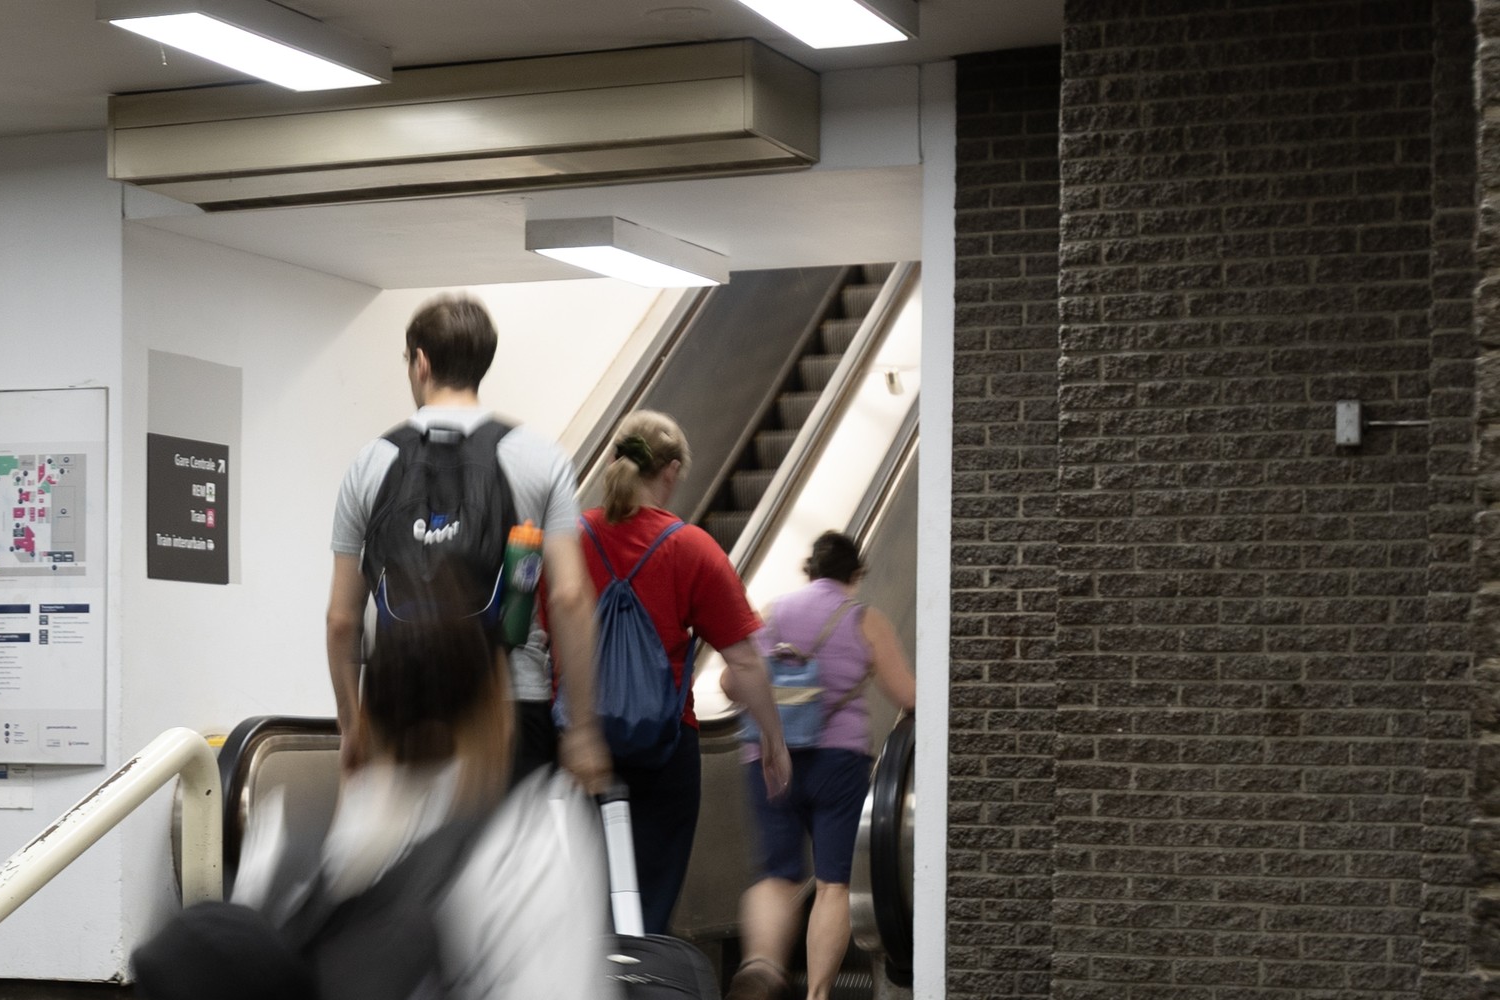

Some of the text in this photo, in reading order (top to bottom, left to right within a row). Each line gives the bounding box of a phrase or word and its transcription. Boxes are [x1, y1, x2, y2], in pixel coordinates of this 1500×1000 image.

[174, 453, 216, 471] Gare Centrale
[190, 509, 206, 523] Train
[156, 533, 172, 547] Train
